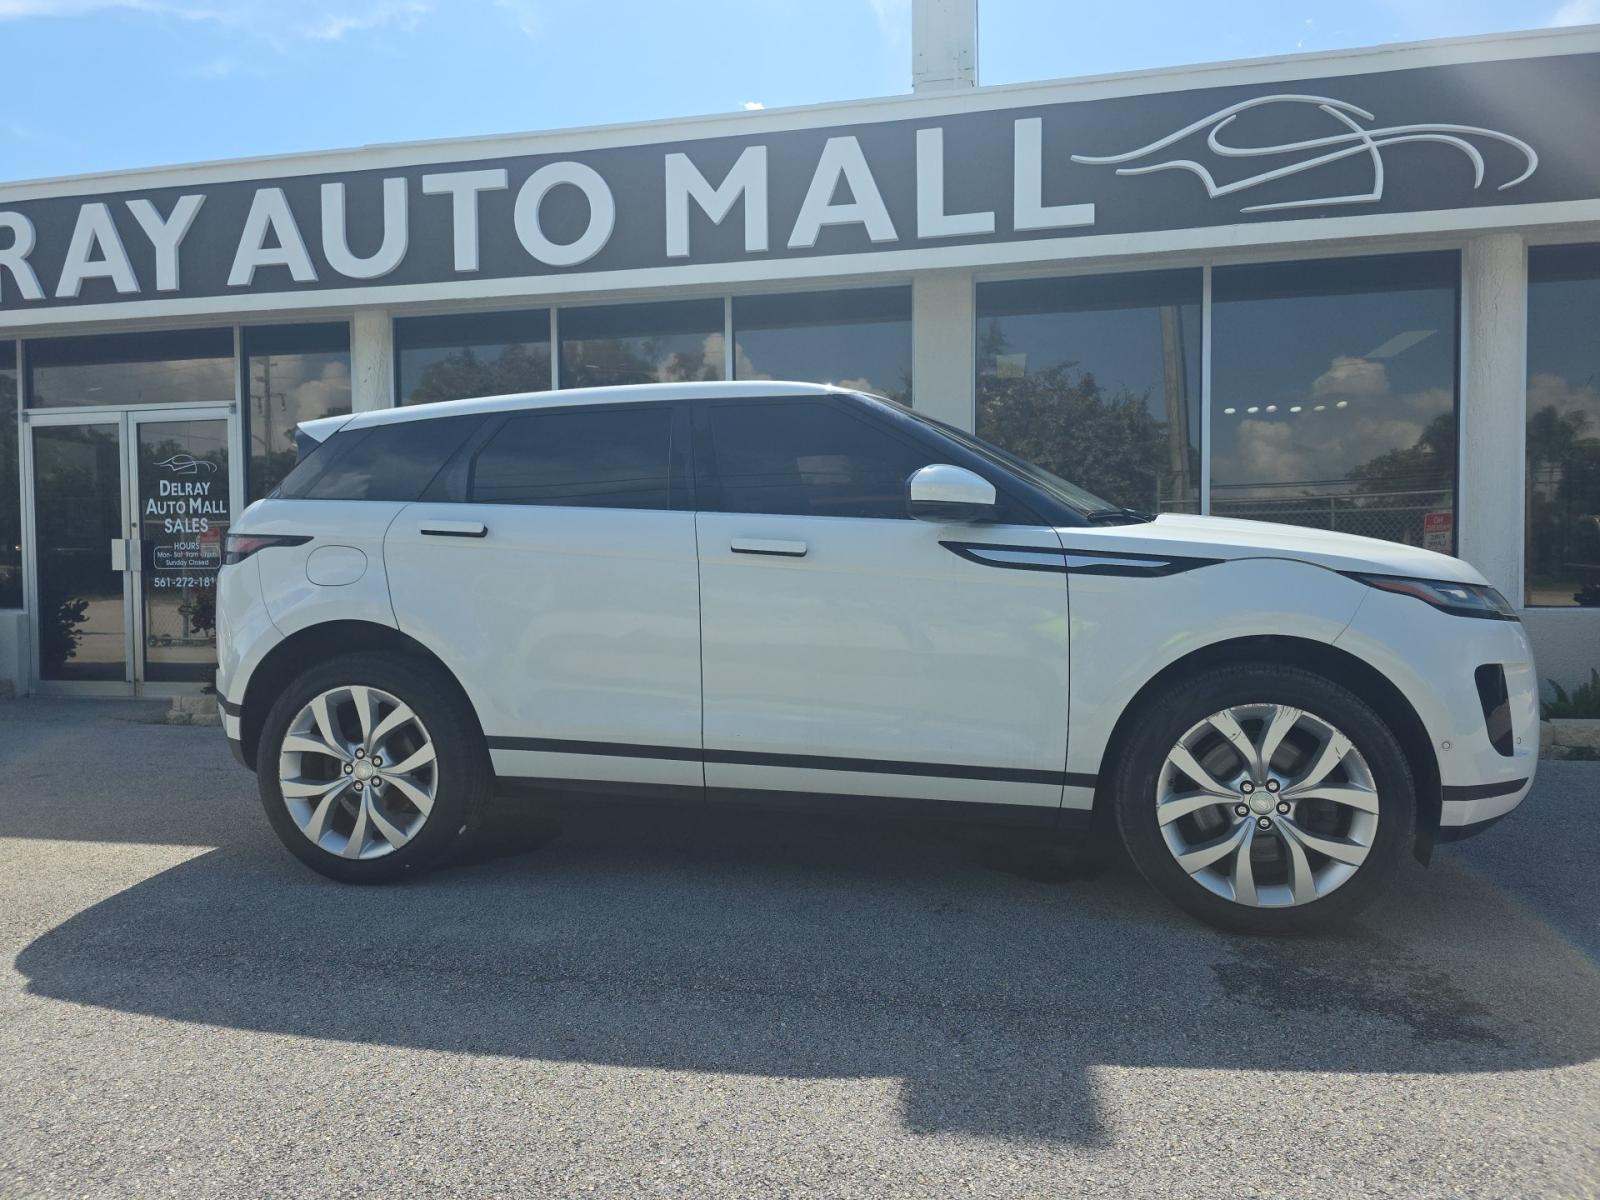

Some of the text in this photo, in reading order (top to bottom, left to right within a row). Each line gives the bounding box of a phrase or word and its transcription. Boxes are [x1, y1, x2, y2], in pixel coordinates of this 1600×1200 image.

[227, 161, 615, 286] AUTO
[665, 117, 1095, 257] MALL
[159, 480, 211, 496] DELRAY
[146, 497, 227, 515] AUTO MALL
[164, 518, 209, 533] SALES
[174, 542, 200, 550] HOURS
[166, 559, 187, 567] Sunday
